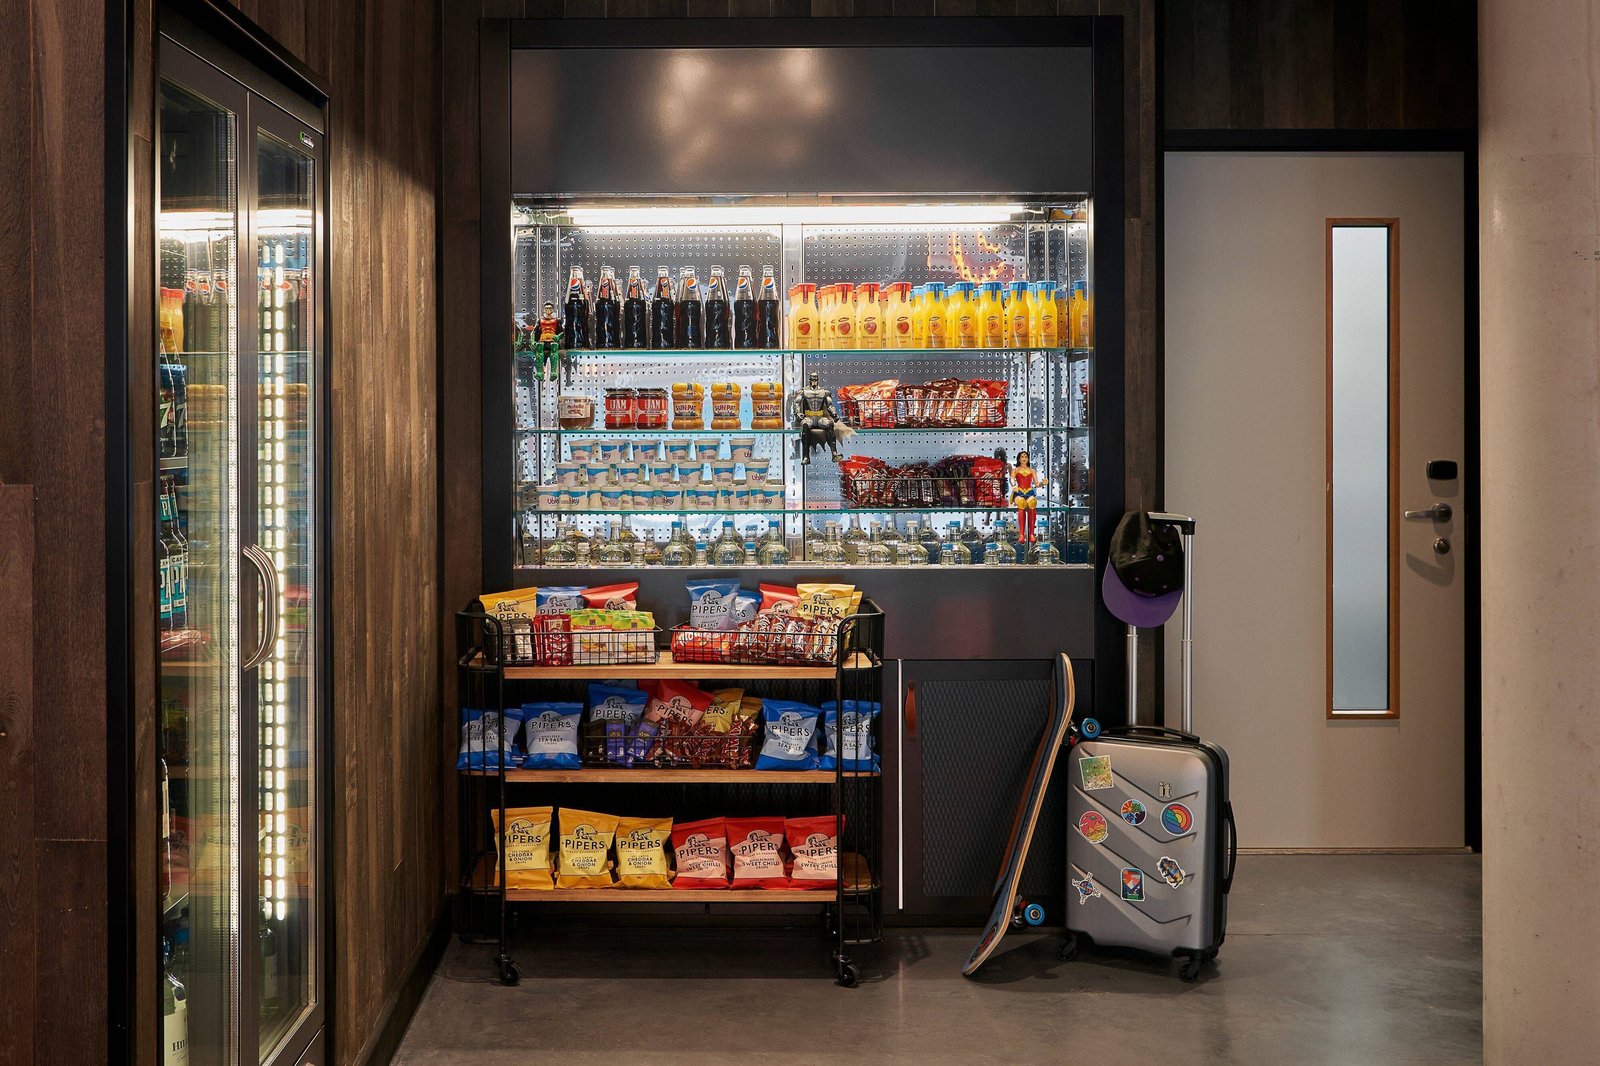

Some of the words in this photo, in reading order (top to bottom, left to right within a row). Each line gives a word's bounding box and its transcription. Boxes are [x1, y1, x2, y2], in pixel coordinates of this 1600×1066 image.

[612, 400, 627, 409] JAM
[647, 400, 660, 409] JAM
[692, 604, 728, 615] PIPERS
[803, 604, 840, 615] PIPERS
[495, 612, 527, 620] IPERS
[595, 709, 634, 720] PIPERS
[656, 703, 693, 727] PIPERS
[706, 706, 727, 715] ERS
[531, 720, 572, 729] PIPERS
[832, 724, 870, 733] PPERS
[771, 725, 810, 737] PIPERS
[1158, 780, 1172, 799] it
[565, 839, 605, 850] PIPERS
[620, 839, 660, 850] PIPERS
[741, 842, 778, 855] PIPERS
[679, 846, 720, 859] PIPERS
[799, 845, 837, 857] PIPERS
